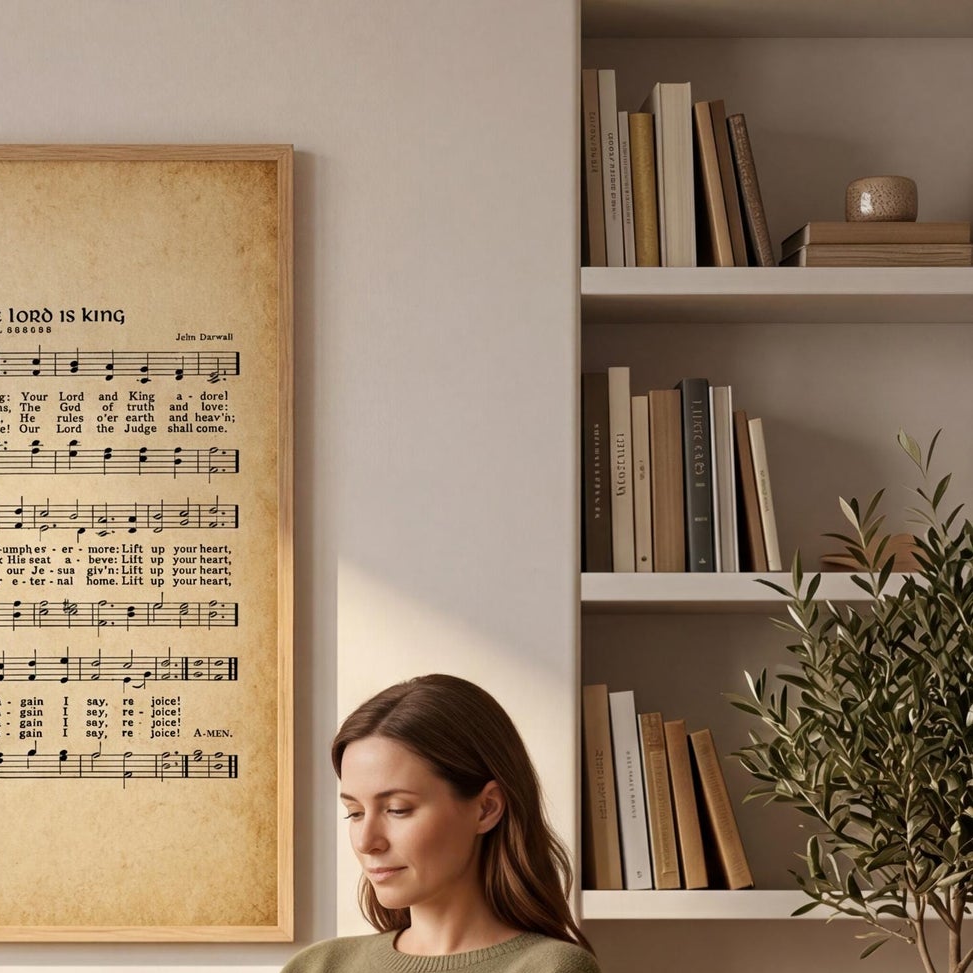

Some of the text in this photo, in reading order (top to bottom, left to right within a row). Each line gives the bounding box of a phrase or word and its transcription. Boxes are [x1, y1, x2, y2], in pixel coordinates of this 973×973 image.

[21, 391, 48, 402] Your
[59, 391, 84, 401] Lord
[99, 391, 118, 401] and
[129, 391, 155, 403] King
[19, 402, 40, 412] The
[102, 402, 114, 412] of
[127, 402, 154, 412] truth
[169, 401, 188, 412] and
[201, 401, 228, 412] love:
[20, 413, 35, 423] He
[57, 413, 83, 423] rules
[97, 412, 118, 423] o'er
[126, 412, 154, 423] earth
[169, 412, 188, 422] and
[19, 423, 40, 434] Our
[56, 423, 82, 434] Lord
[96, 423, 114, 433] the
[124, 423, 157, 436] Judge
[168, 423, 192, 433] shall
[196, 425, 228, 433] come.
[88, 546, 119, 554] more:
[122, 543, 143, 554] Lift
[151, 546, 165, 556] up
[173, 546, 198, 556] your
[199, 543, 232, 556] heart,
[29, 554, 51, 565] seat
[122, 554, 143, 564] Lift
[151, 556, 164, 566] up
[172, 556, 198, 566] your
[199, 554, 232, 566] heart,
[6, 567, 25, 575] our
[122, 565, 143, 575] Lift
[150, 567, 163, 577] up
[172, 567, 198, 577] your
[199, 564, 232, 577] heart,
[57, 576, 73, 586] nal
[86, 576, 118, 586] home.
[122, 576, 143, 586] Lift
[150, 578, 165, 588] up
[172, 578, 198, 588] your
[199, 575, 232, 588] heart,
[20, 696, 44, 709] gain
[63, 696, 69, 706] I
[150, 696, 181, 708] joice!
[62, 707, 68, 717] I
[150, 706, 181, 719] joice!
[19, 717, 43, 730] gain
[62, 717, 68, 728] I
[150, 717, 181, 730] joice!
[19, 728, 43, 741] gain
[62, 728, 68, 738] I
[150, 728, 180, 740] joice!
